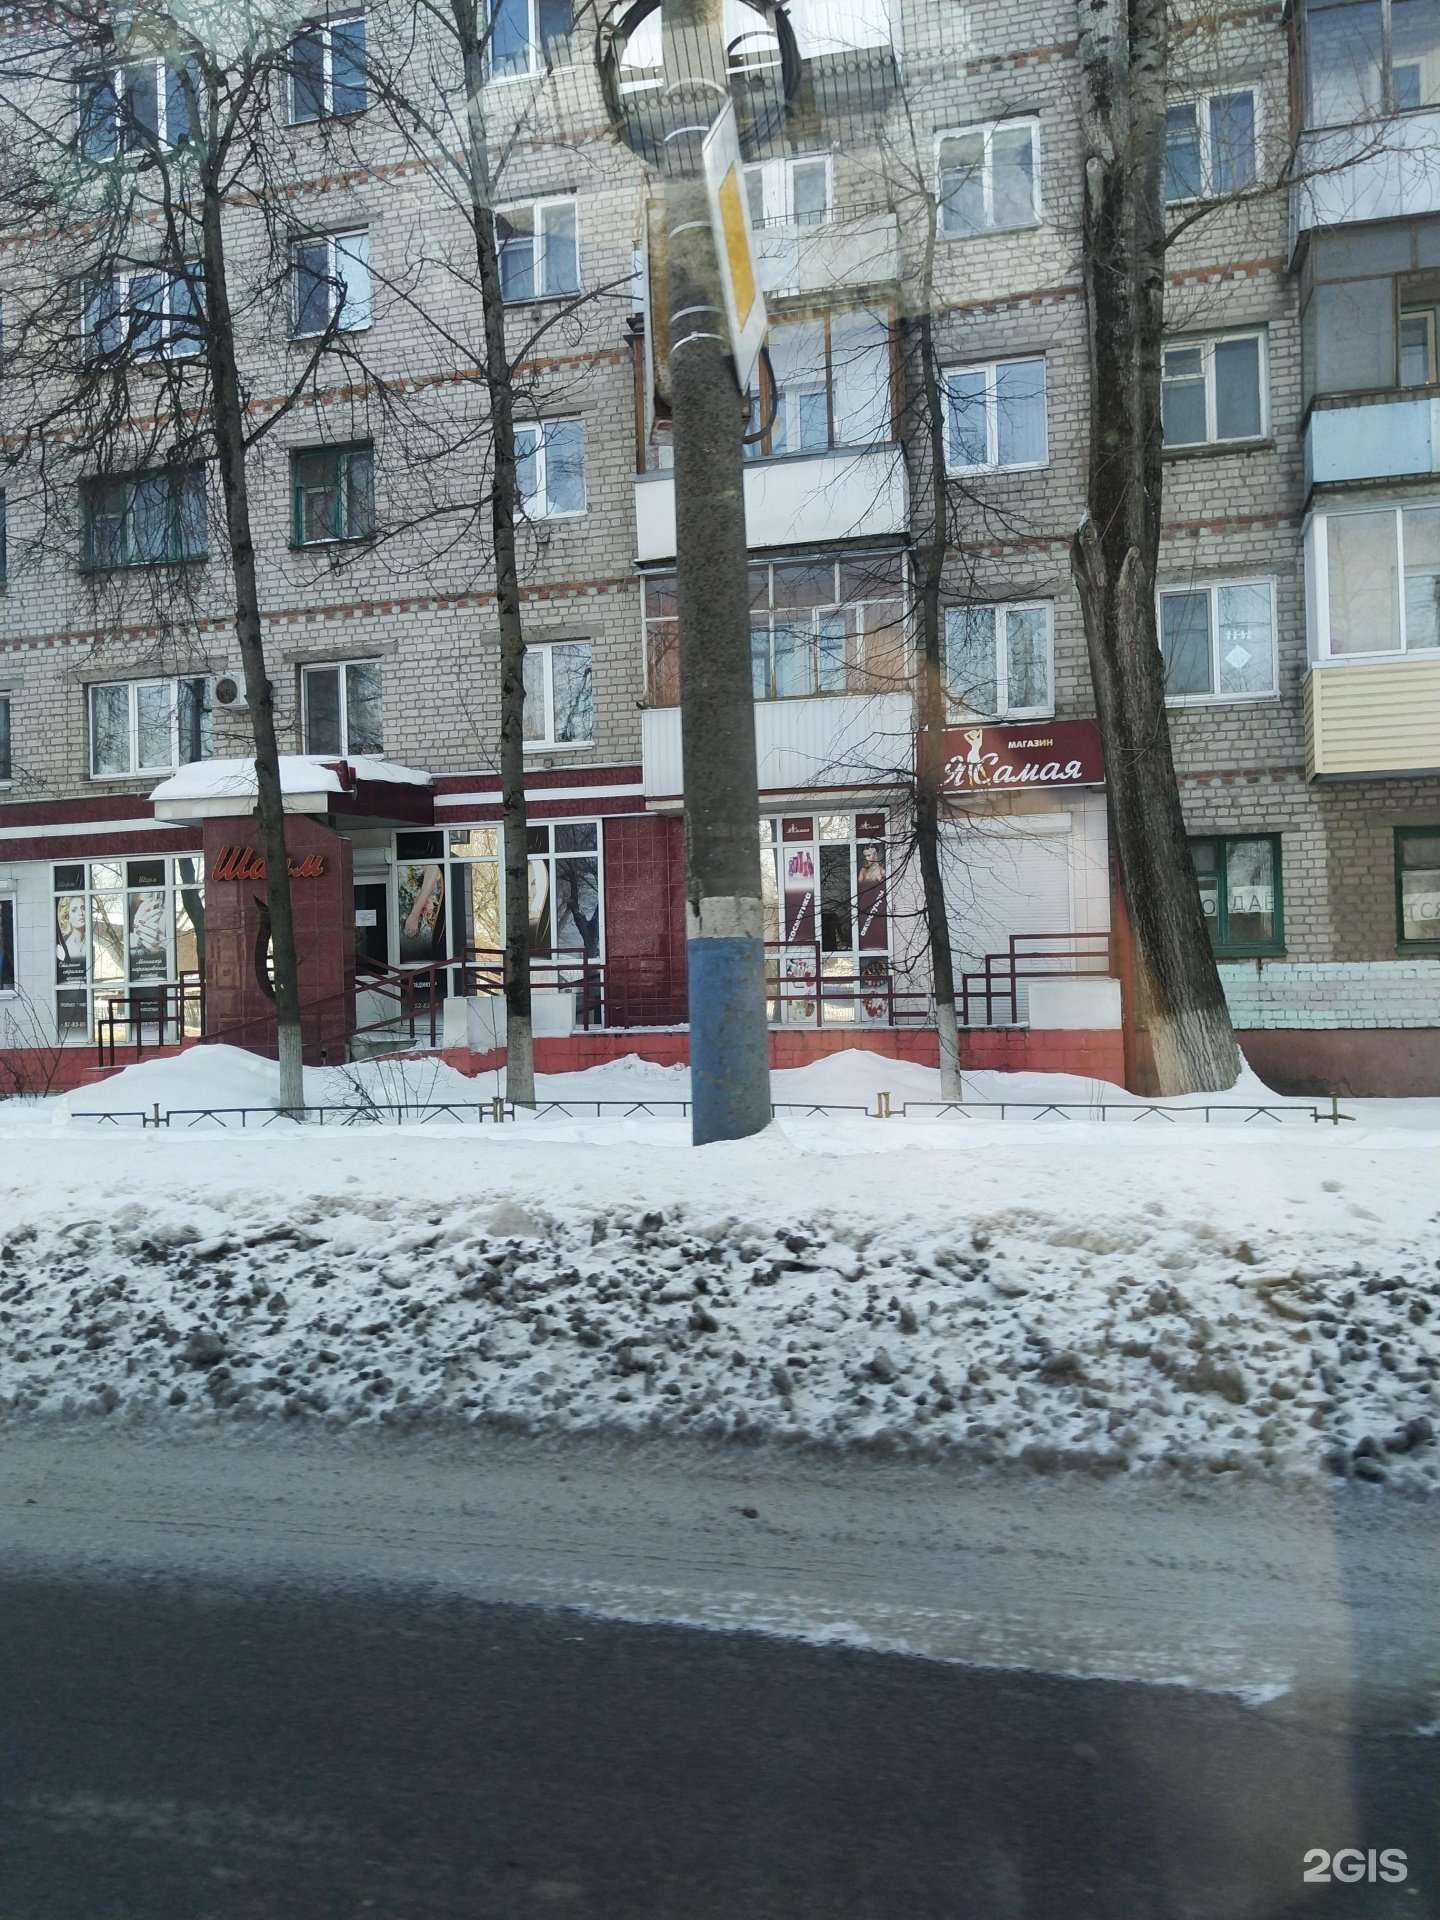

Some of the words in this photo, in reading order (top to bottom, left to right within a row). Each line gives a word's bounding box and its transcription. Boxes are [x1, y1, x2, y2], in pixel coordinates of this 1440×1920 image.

[1008, 738, 1054, 749] МАГАЗИН
[973, 752, 1083, 785] Самая
[212, 847, 325, 880] Шам
